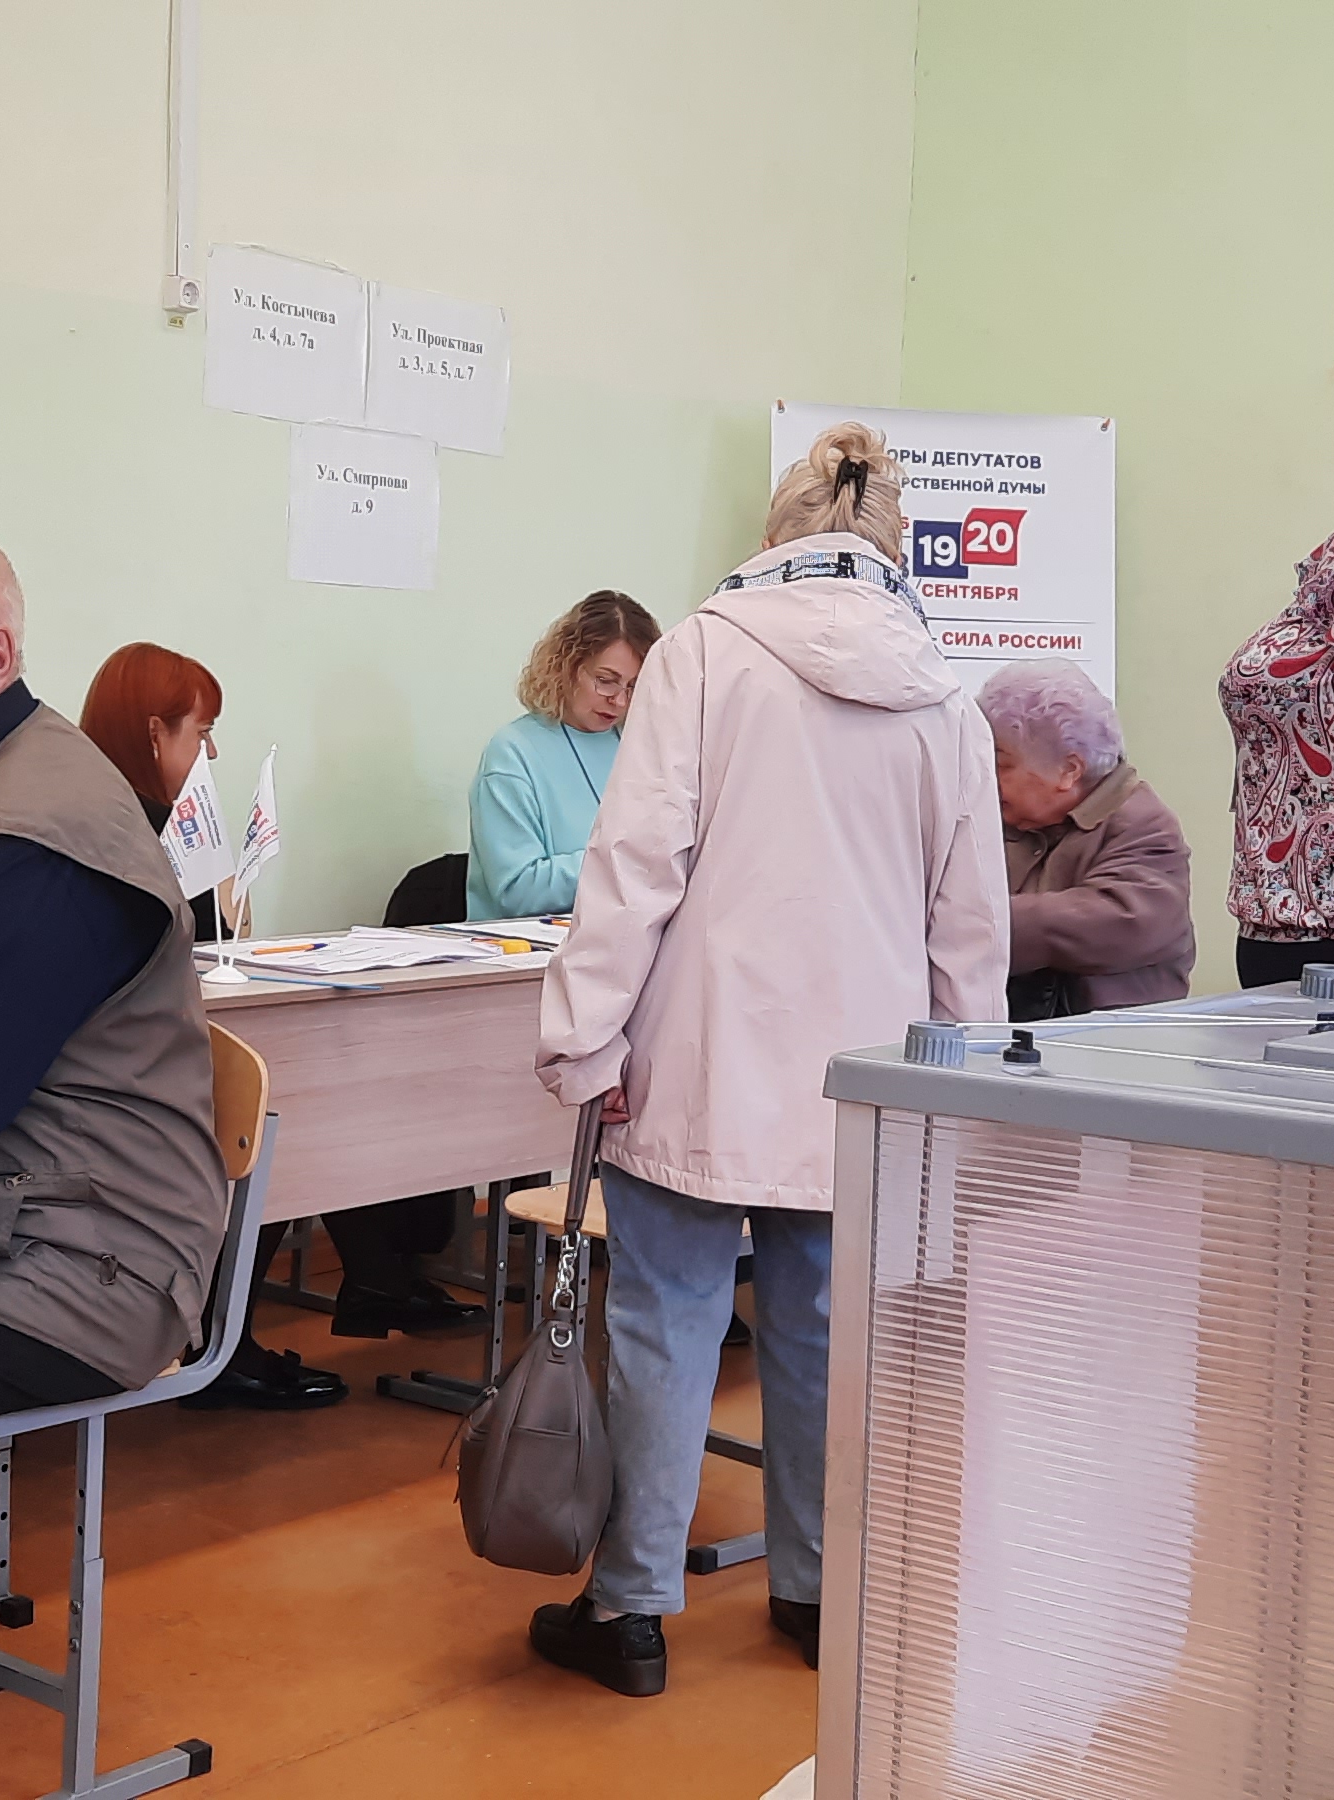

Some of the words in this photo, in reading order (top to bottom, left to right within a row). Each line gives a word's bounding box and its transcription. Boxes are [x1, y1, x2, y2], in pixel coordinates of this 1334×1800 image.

[233, 288, 256, 308] Ул.
[261, 294, 336, 325] Костычева
[252, 327, 266, 341] д.
[269, 326, 281, 346] 4,
[299, 332, 314, 350] 7а
[392, 322, 413, 341] Ул.
[417, 327, 484, 354] Проектная
[412, 355, 424, 375] 3,
[440, 360, 452, 380] 5,
[886, 448, 927, 464] ОРЫ
[931, 450, 1043, 470] ДЕПУТАТОВ
[316, 463, 339, 482] Ул.
[342, 467, 409, 491] Смирнова
[901, 476, 995, 493] РСТВЕННОЙ
[997, 482, 1047, 495] ДУМЫ
[351, 501, 363, 514] д.
[365, 498, 374, 514] 9
[966, 520, 1015, 554] 20
[918, 534, 958, 567] 19
[921, 583, 1020, 601] СЕНТЯБРЯ
[941, 631, 994, 648] СИЛА
[998, 634, 1083, 650] РОССИИ!
